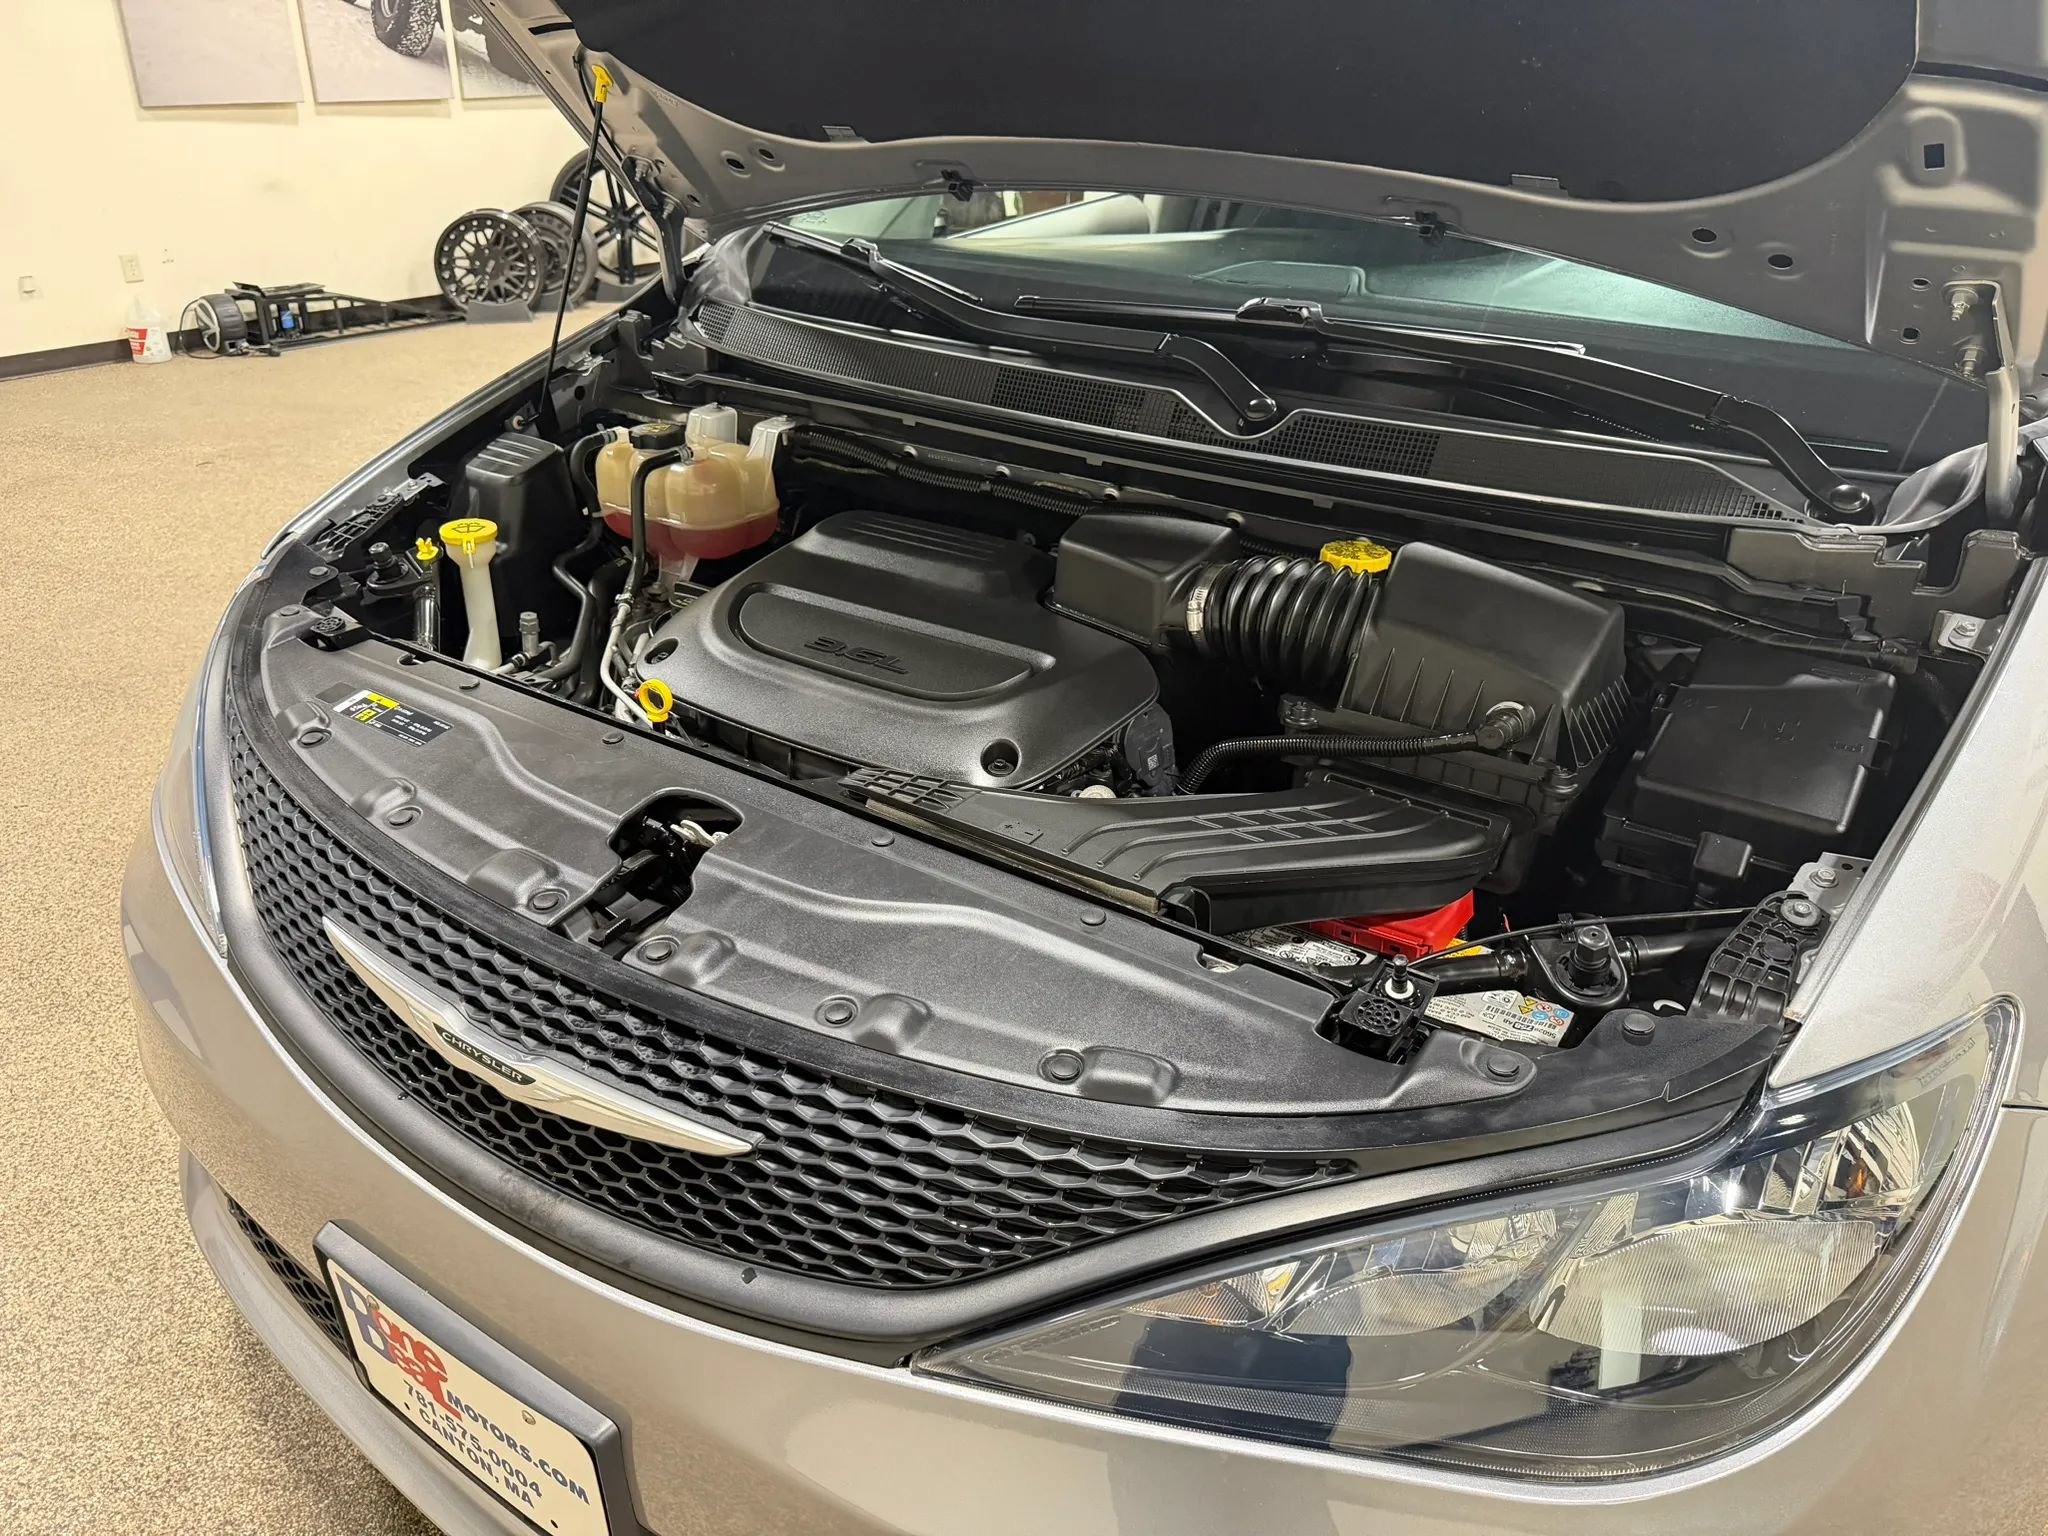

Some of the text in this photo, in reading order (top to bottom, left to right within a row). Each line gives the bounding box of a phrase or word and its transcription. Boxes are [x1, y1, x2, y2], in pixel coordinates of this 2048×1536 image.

[804, 635, 910, 675] 3.6L
[440, 1031, 523, 1081] CHRYSLER
[402, 1379, 543, 1499] 781-575-0004
[418, 1406, 535, 1509] CANTON, MA
[446, 1388, 590, 1506] MOTORS.COM
